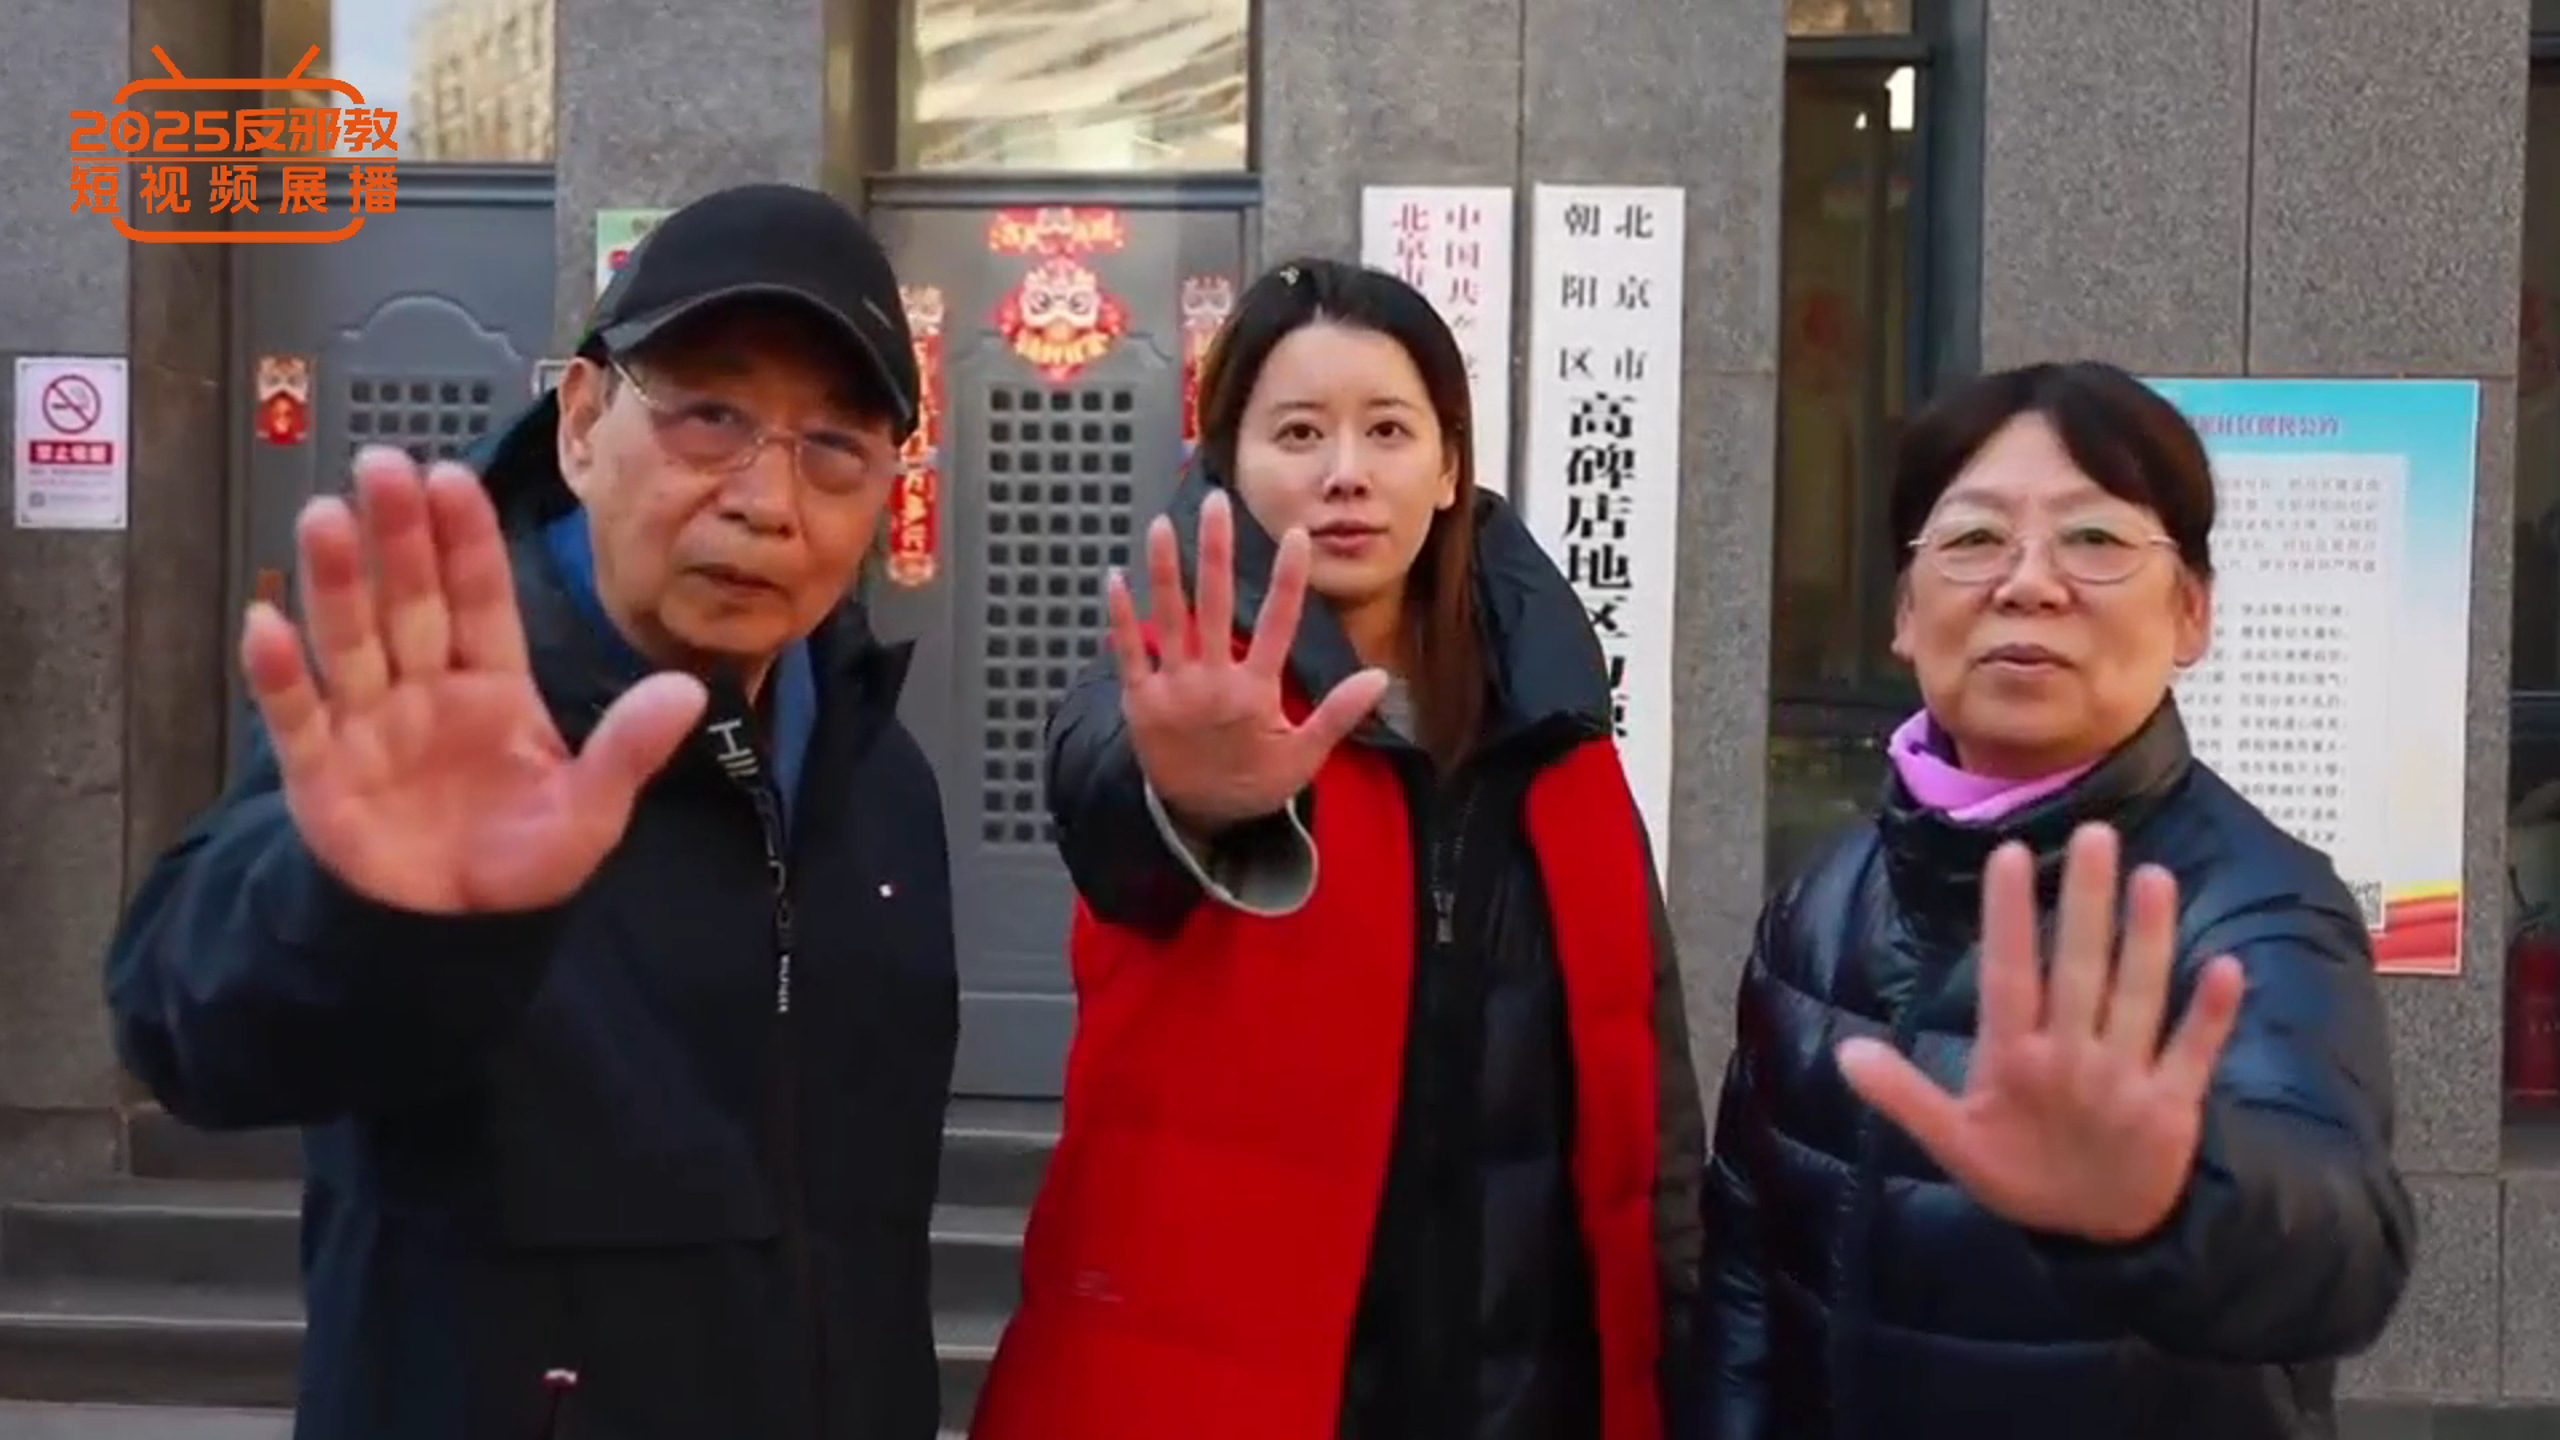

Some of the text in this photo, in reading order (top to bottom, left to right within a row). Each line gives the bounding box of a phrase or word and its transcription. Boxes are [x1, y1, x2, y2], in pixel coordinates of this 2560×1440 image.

[1559, 203, 1600, 380] 朝阳区
[1613, 203, 1653, 381] 北京市
